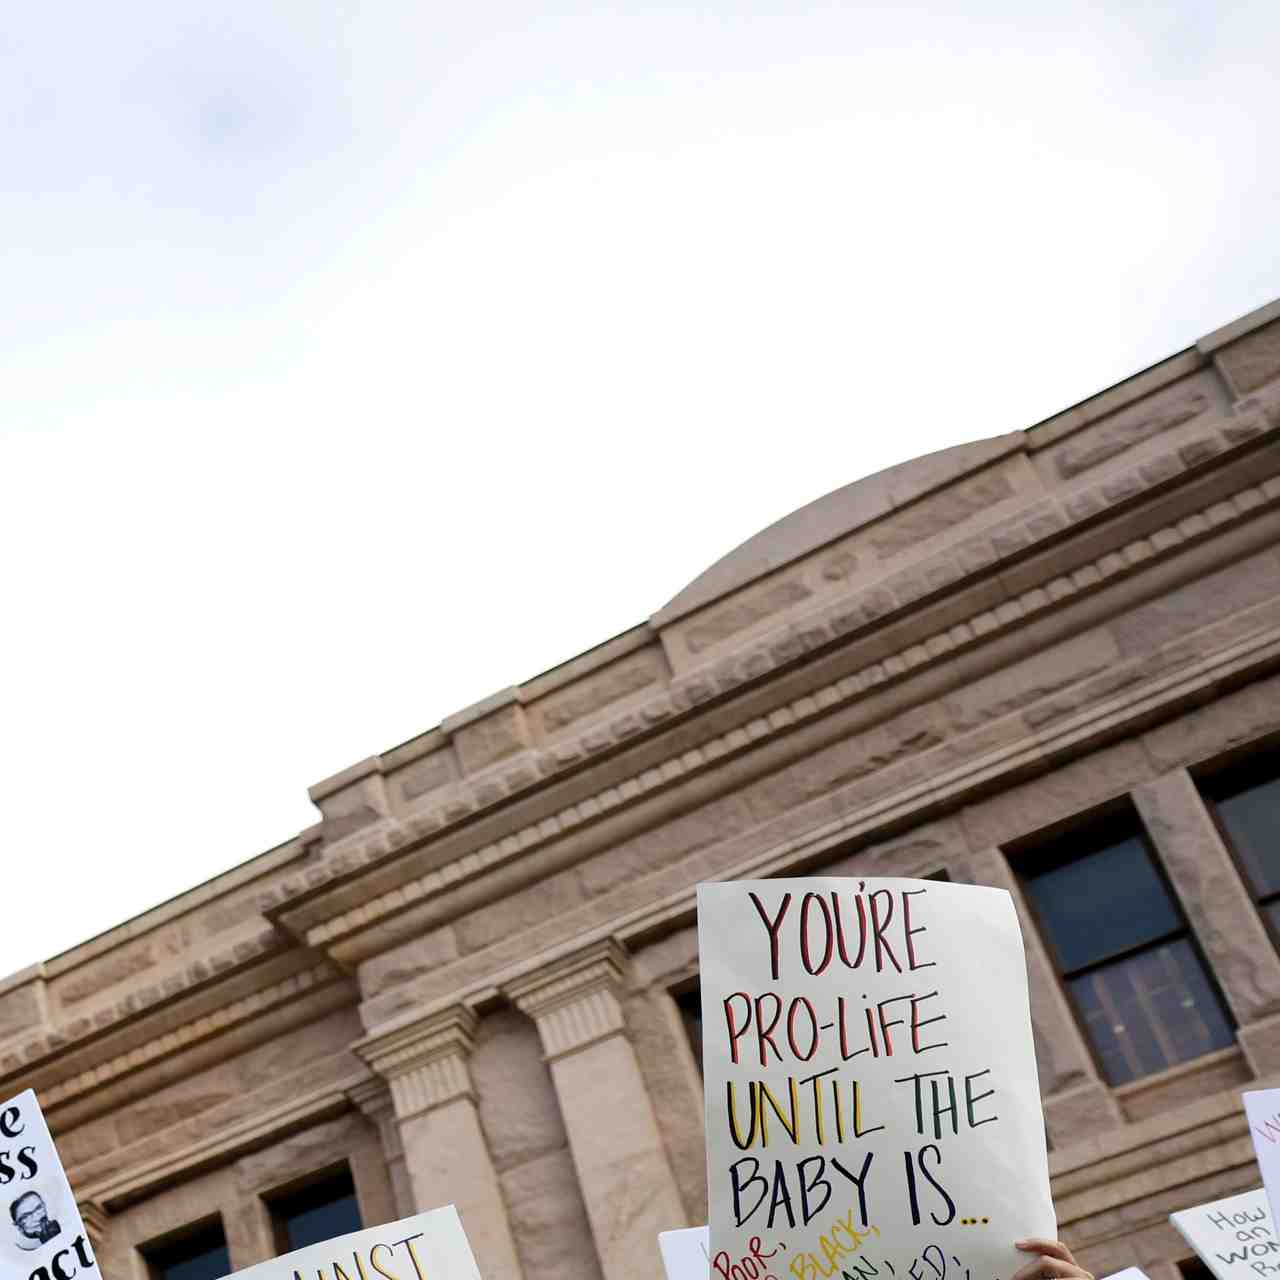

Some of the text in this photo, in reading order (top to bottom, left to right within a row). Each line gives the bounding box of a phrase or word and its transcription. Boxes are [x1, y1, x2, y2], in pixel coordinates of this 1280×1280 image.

[726, 1067, 999, 1151] UNTIL THE
[729, 1152, 874, 1229] BABY
